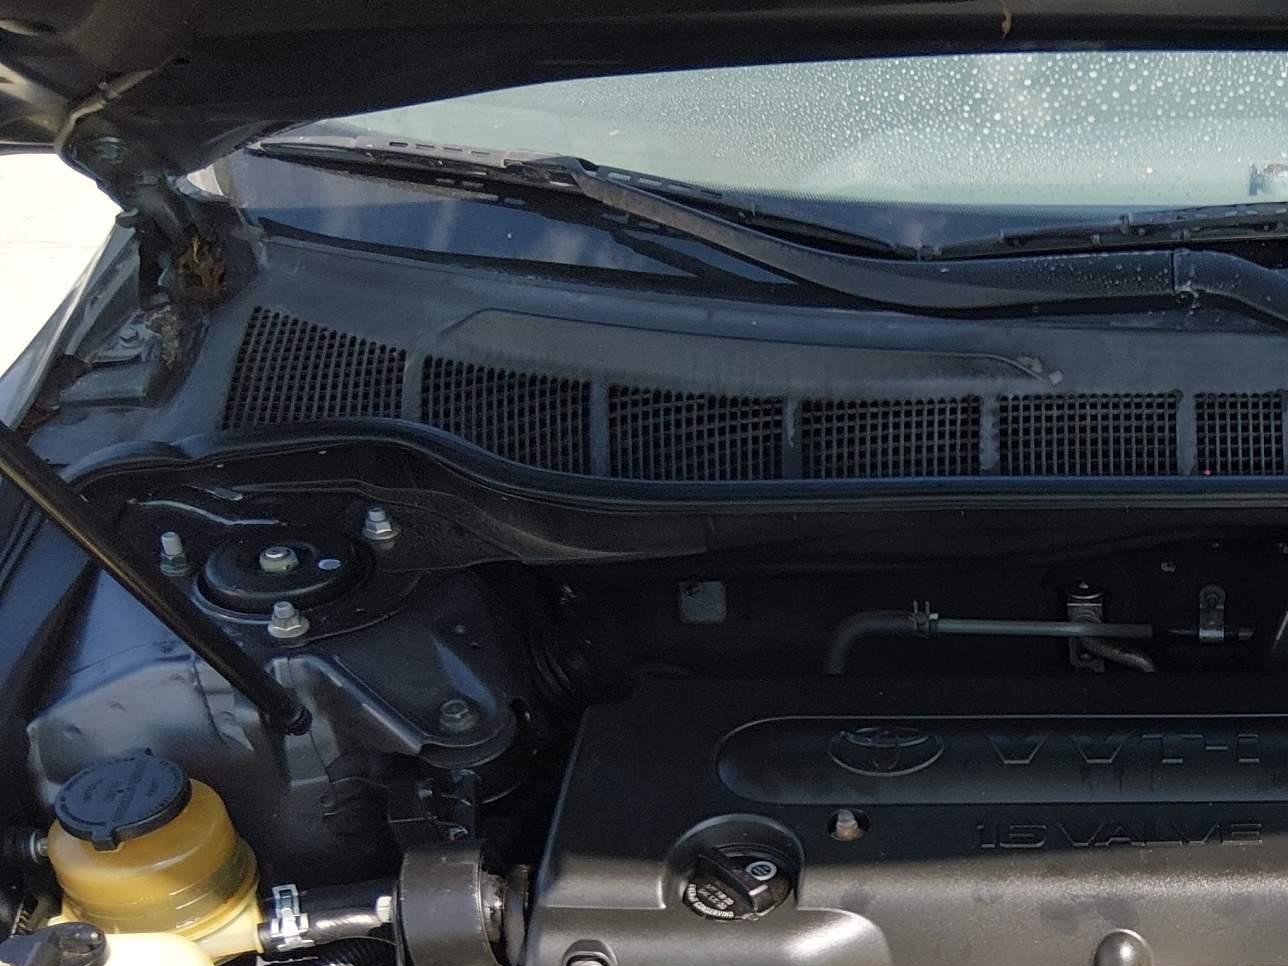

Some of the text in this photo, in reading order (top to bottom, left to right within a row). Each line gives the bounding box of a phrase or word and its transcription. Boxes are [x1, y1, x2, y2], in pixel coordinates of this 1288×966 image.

[976, 822, 1263, 849] 16 VALVE
[692, 900, 736, 918] CONSERVING
